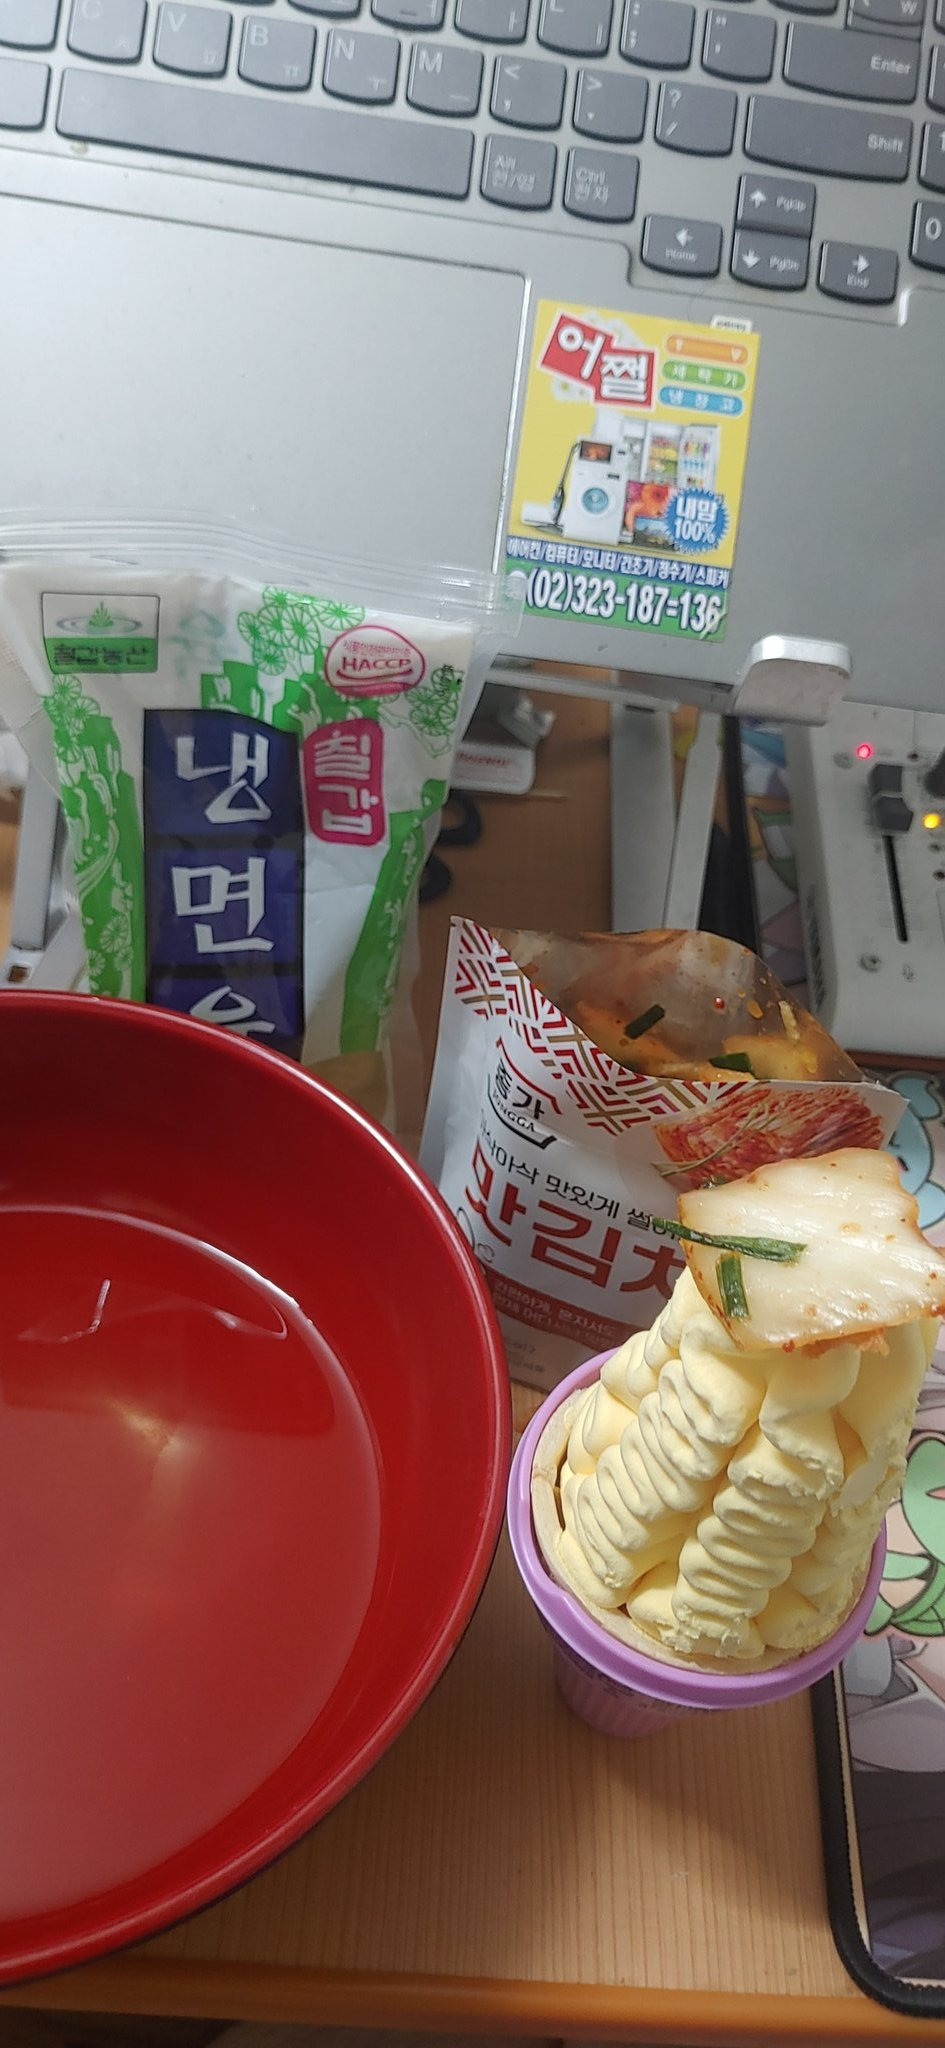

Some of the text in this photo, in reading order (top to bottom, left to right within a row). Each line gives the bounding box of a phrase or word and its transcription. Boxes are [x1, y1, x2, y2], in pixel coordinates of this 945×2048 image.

[167, 11, 186, 32] V
[251, 24, 269, 46] B
[335, 38, 355, 60] N
[418, 51, 444, 73] M
[870, 55, 911, 75] Enter
[867, 133, 904, 152] Shift
[925, 217, 943, 240] 0
[558, 323, 649, 404] 어쩔
[675, 495, 718, 523] 내맘
[674, 517, 716, 544] 100%
[342, 656, 412, 672] HACCP
[314, 730, 380, 836] 칠갑
[494, 1056, 545, 1120] 종가
[546, 1174, 621, 1219] 맛있게
